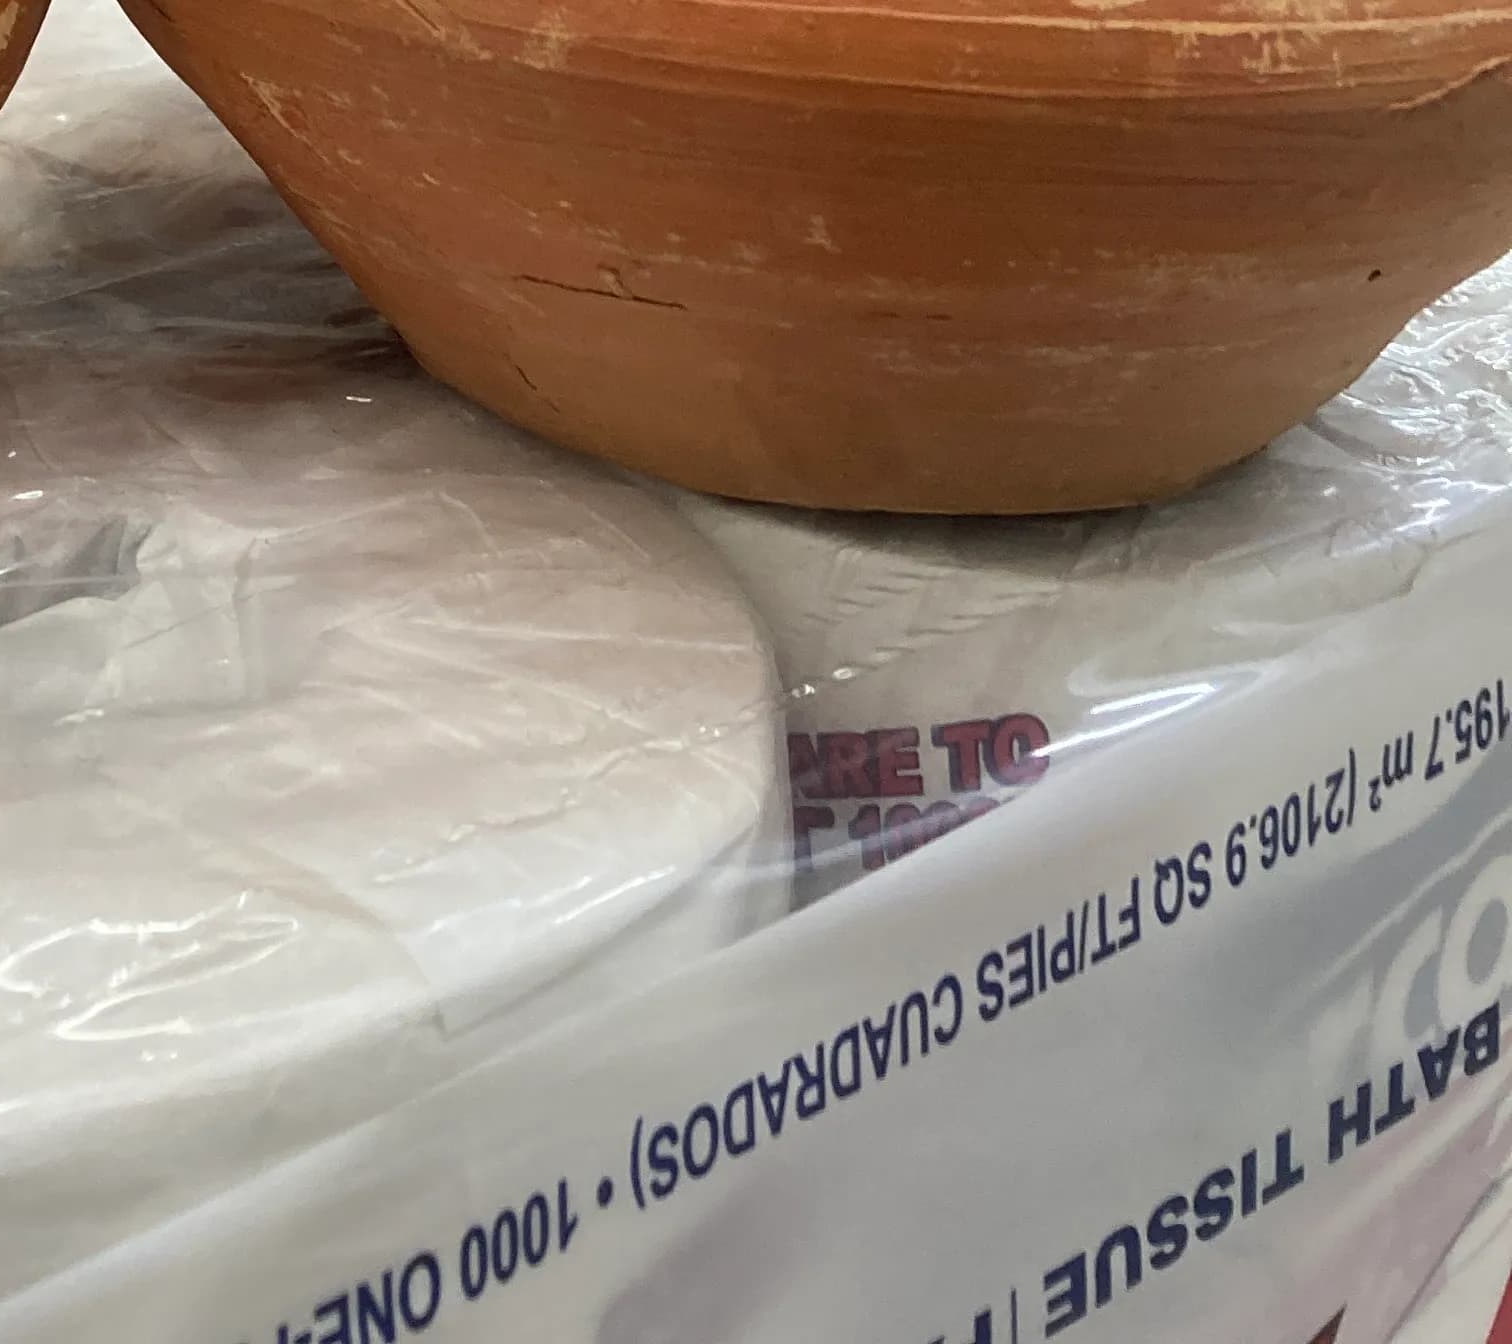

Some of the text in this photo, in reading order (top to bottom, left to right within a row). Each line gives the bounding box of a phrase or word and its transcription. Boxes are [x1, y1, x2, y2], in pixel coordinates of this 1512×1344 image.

[931, 712, 1050, 794] TO
[1424, 678, 1511, 781] 195.7
[1153, 841, 1214, 925] SQ
[1225, 747, 1357, 888] (2106.9
[976, 875, 1142, 1022] FT/PIES
[630, 972, 966, 1210] CUADRADOS)
[1043, 1002, 1502, 1339] BATH TISSUE
[460, 1177, 580, 1300] 1000
